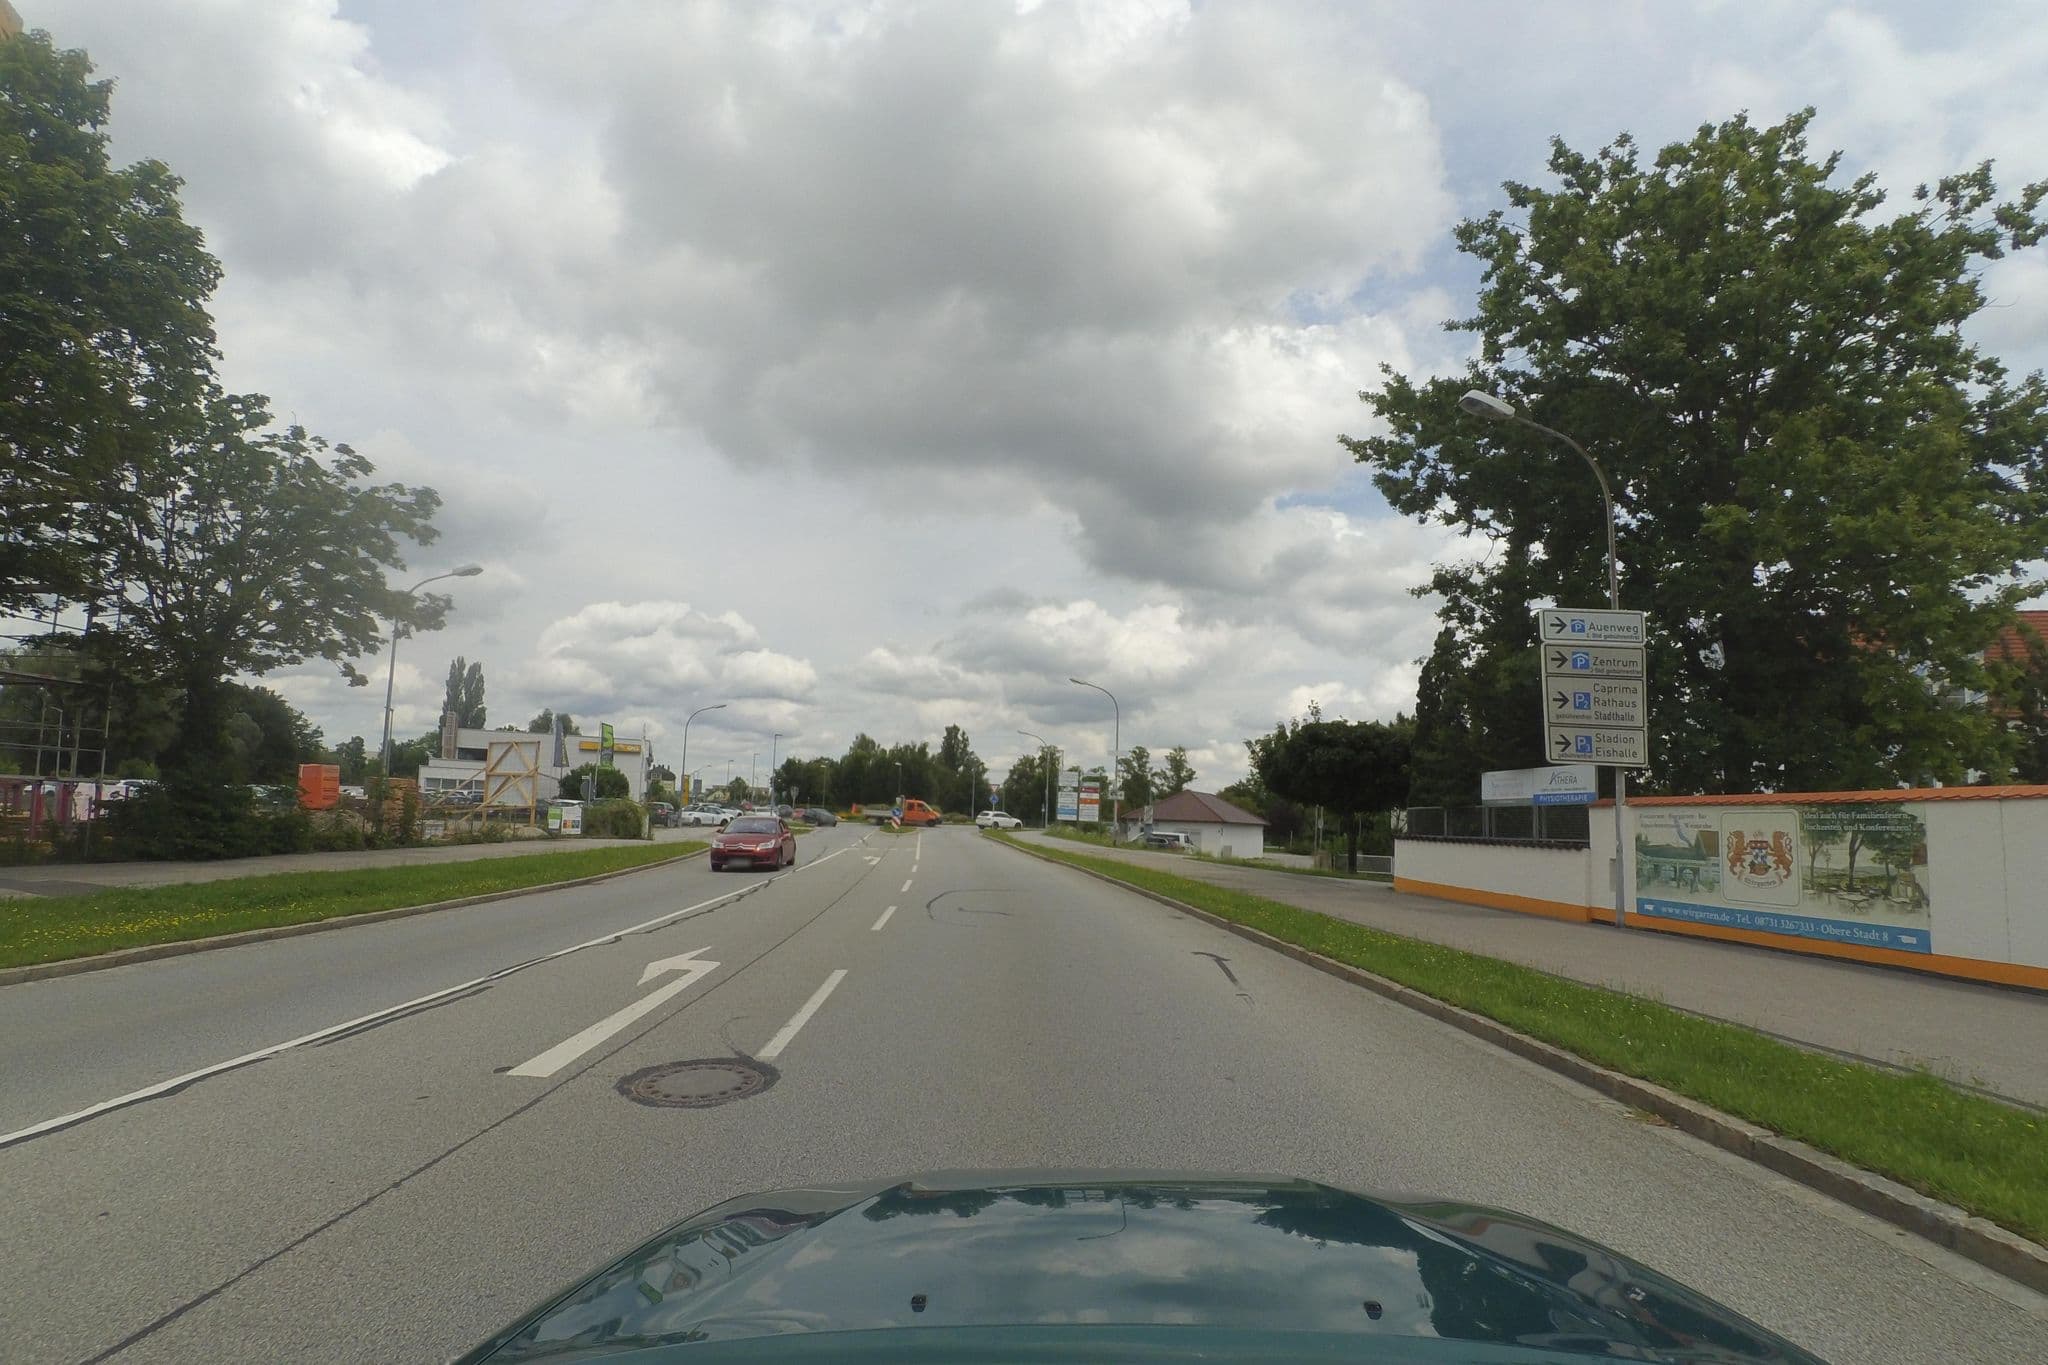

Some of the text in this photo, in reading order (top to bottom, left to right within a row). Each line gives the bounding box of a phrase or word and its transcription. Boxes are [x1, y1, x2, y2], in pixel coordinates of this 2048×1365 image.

[1589, 622, 1639, 634] Auenweg
[1592, 656, 1638, 667] Zentrum
[1593, 683, 1638, 695] Caprima
[1593, 697, 1637, 708] Rathaus
[1594, 711, 1635, 722] Stadthalle
[1595, 733, 1635, 744] Stadion
[1595, 747, 1638, 758] Eishalle
[1539, 794, 1589, 803] PHYSIOTHERAPIE
[1754, 916, 1778, 928] 08731
[1820, 923, 1851, 937] Obere
[1853, 927, 1880, 940] Stadt
[1882, 931, 1889, 941] 8
